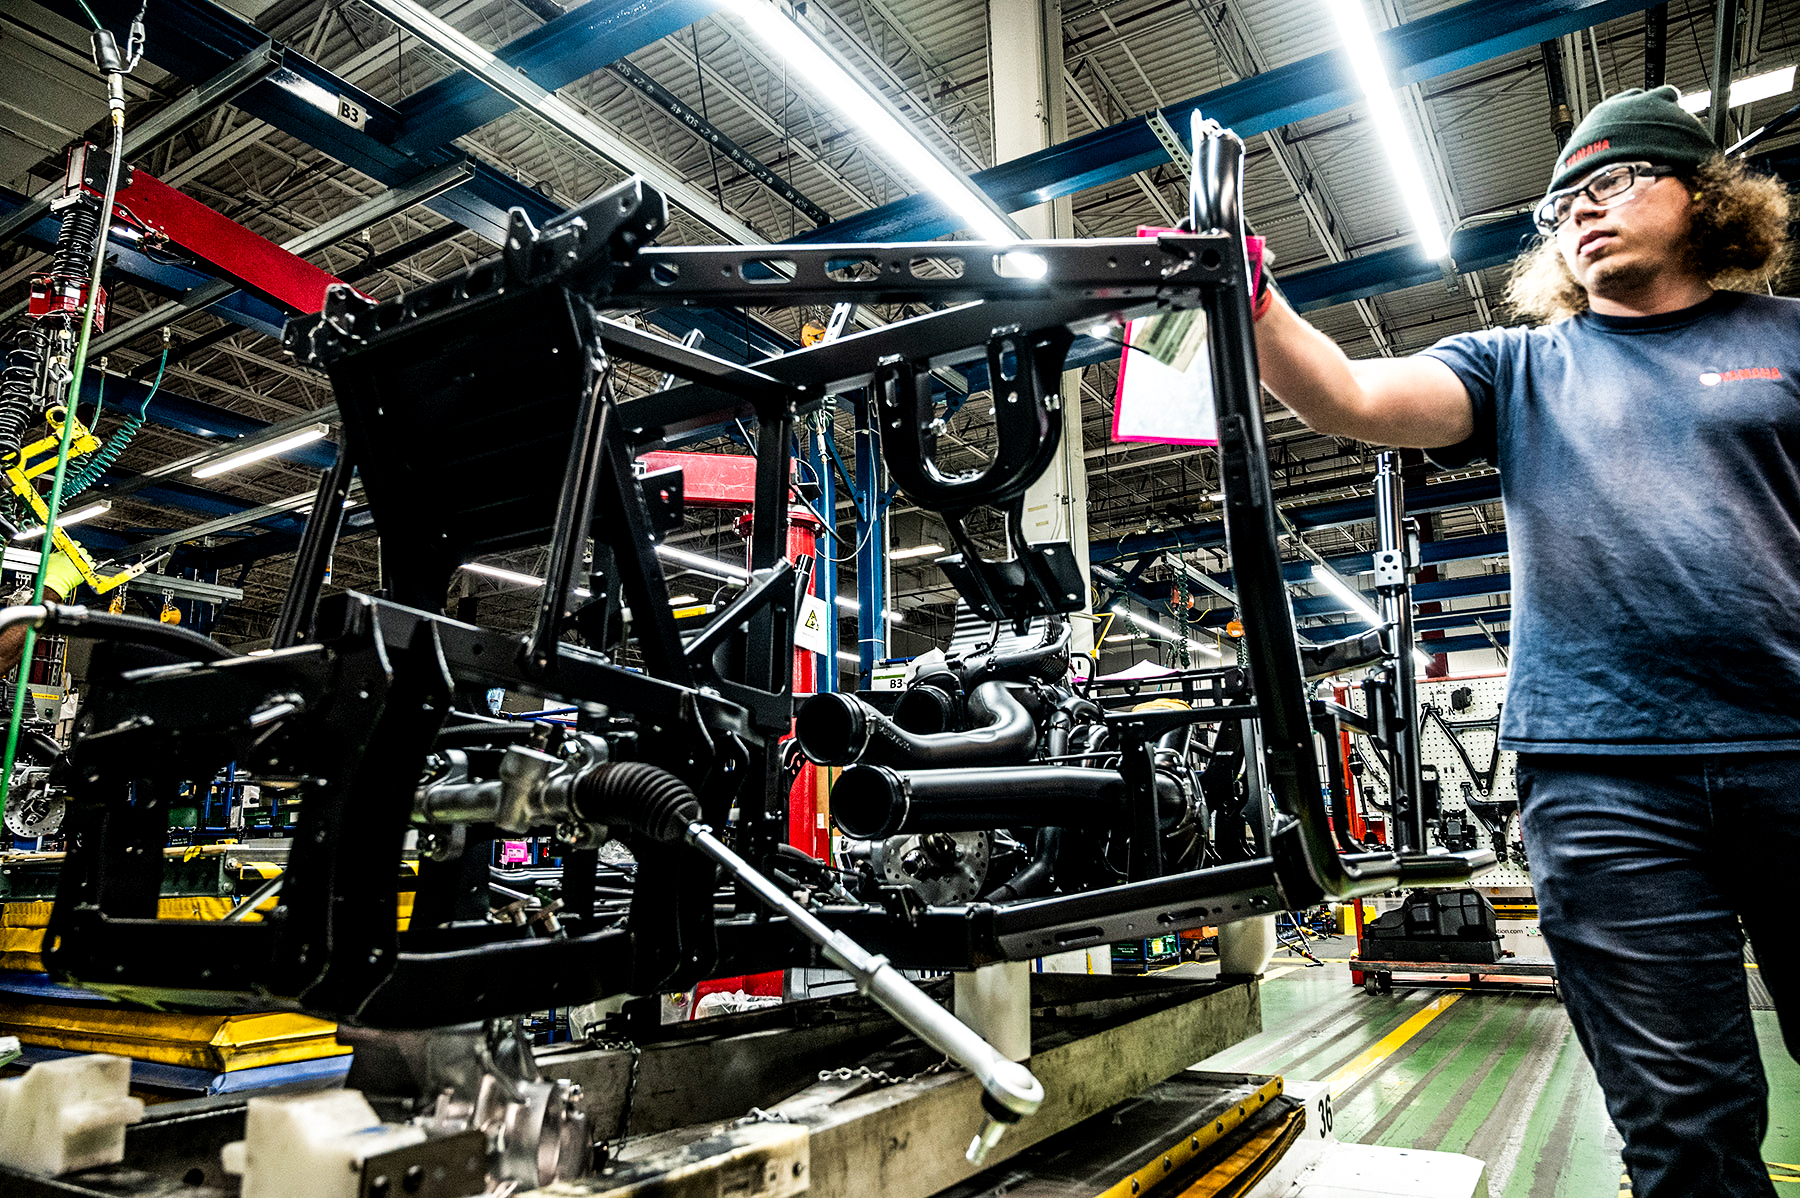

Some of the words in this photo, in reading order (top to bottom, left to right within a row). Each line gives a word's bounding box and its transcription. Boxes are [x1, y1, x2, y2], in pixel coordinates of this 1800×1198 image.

[341, 101, 359, 123] B3
[683, 113, 699, 128] SCH
[1566, 139, 1611, 168] YAMAHA
[742, 157, 756, 171] SCH
[794, 199, 808, 210] SCH
[890, 679, 903, 688] B3
[1318, 1094, 1333, 1139] 36
